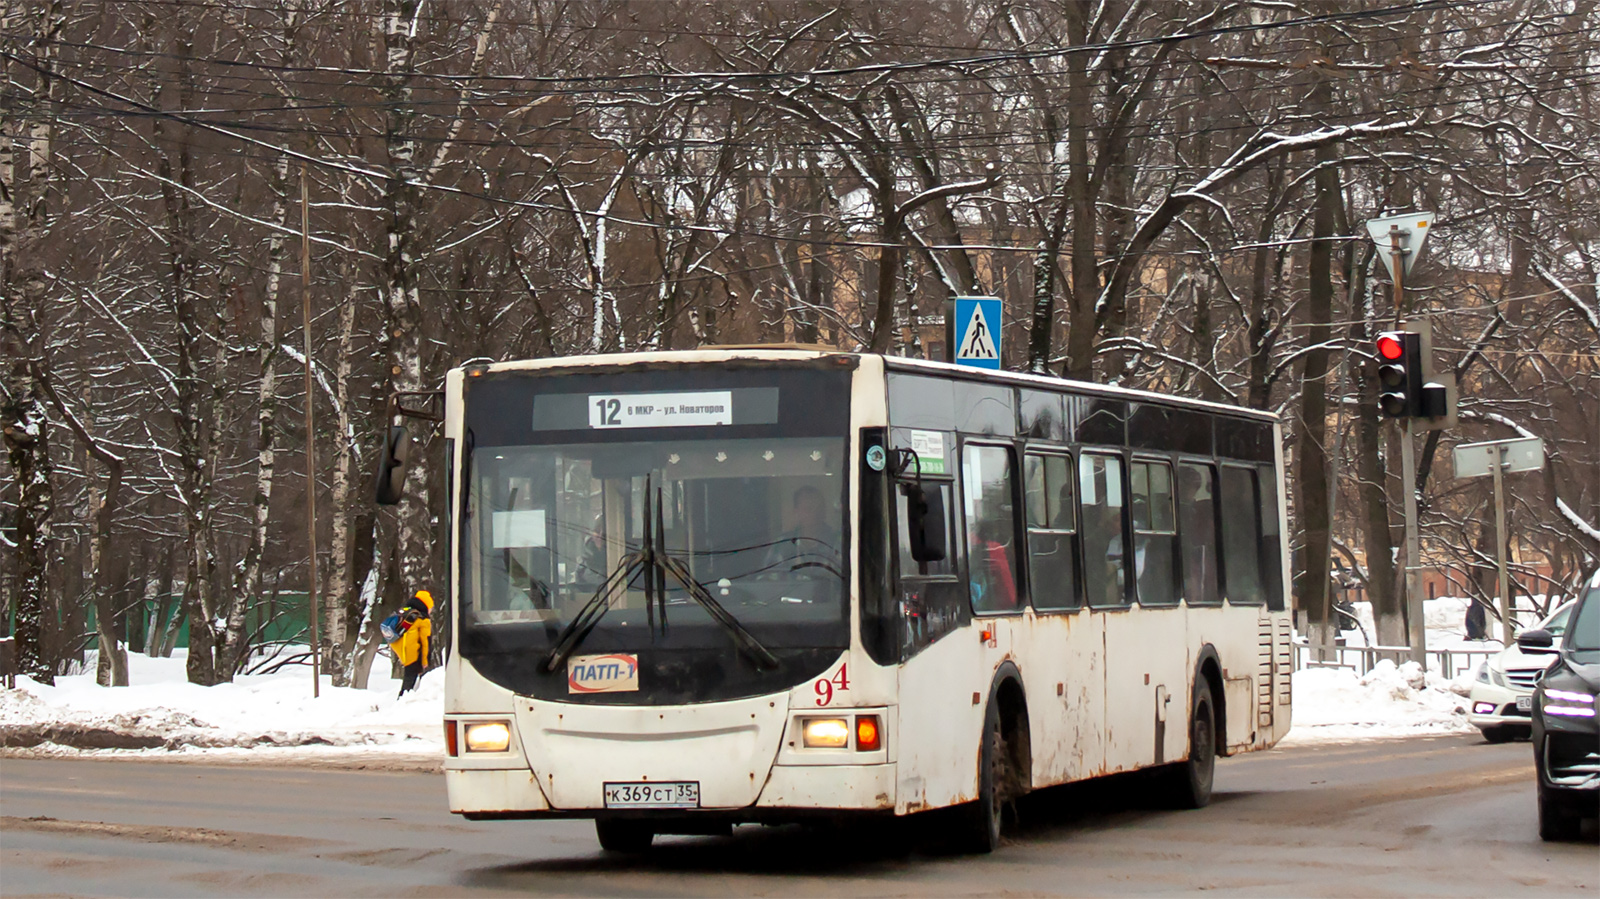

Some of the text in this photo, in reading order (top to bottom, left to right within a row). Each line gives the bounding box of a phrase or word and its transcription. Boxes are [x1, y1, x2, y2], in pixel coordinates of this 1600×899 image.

[596, 398, 622, 426] 12
[635, 405, 655, 416] МКР
[664, 406, 677, 416] ул.
[679, 404, 725, 415] Новаторов
[573, 663, 635, 682] ПАТП-1
[814, 662, 851, 707] 94
[677, 784, 693, 797] 35
